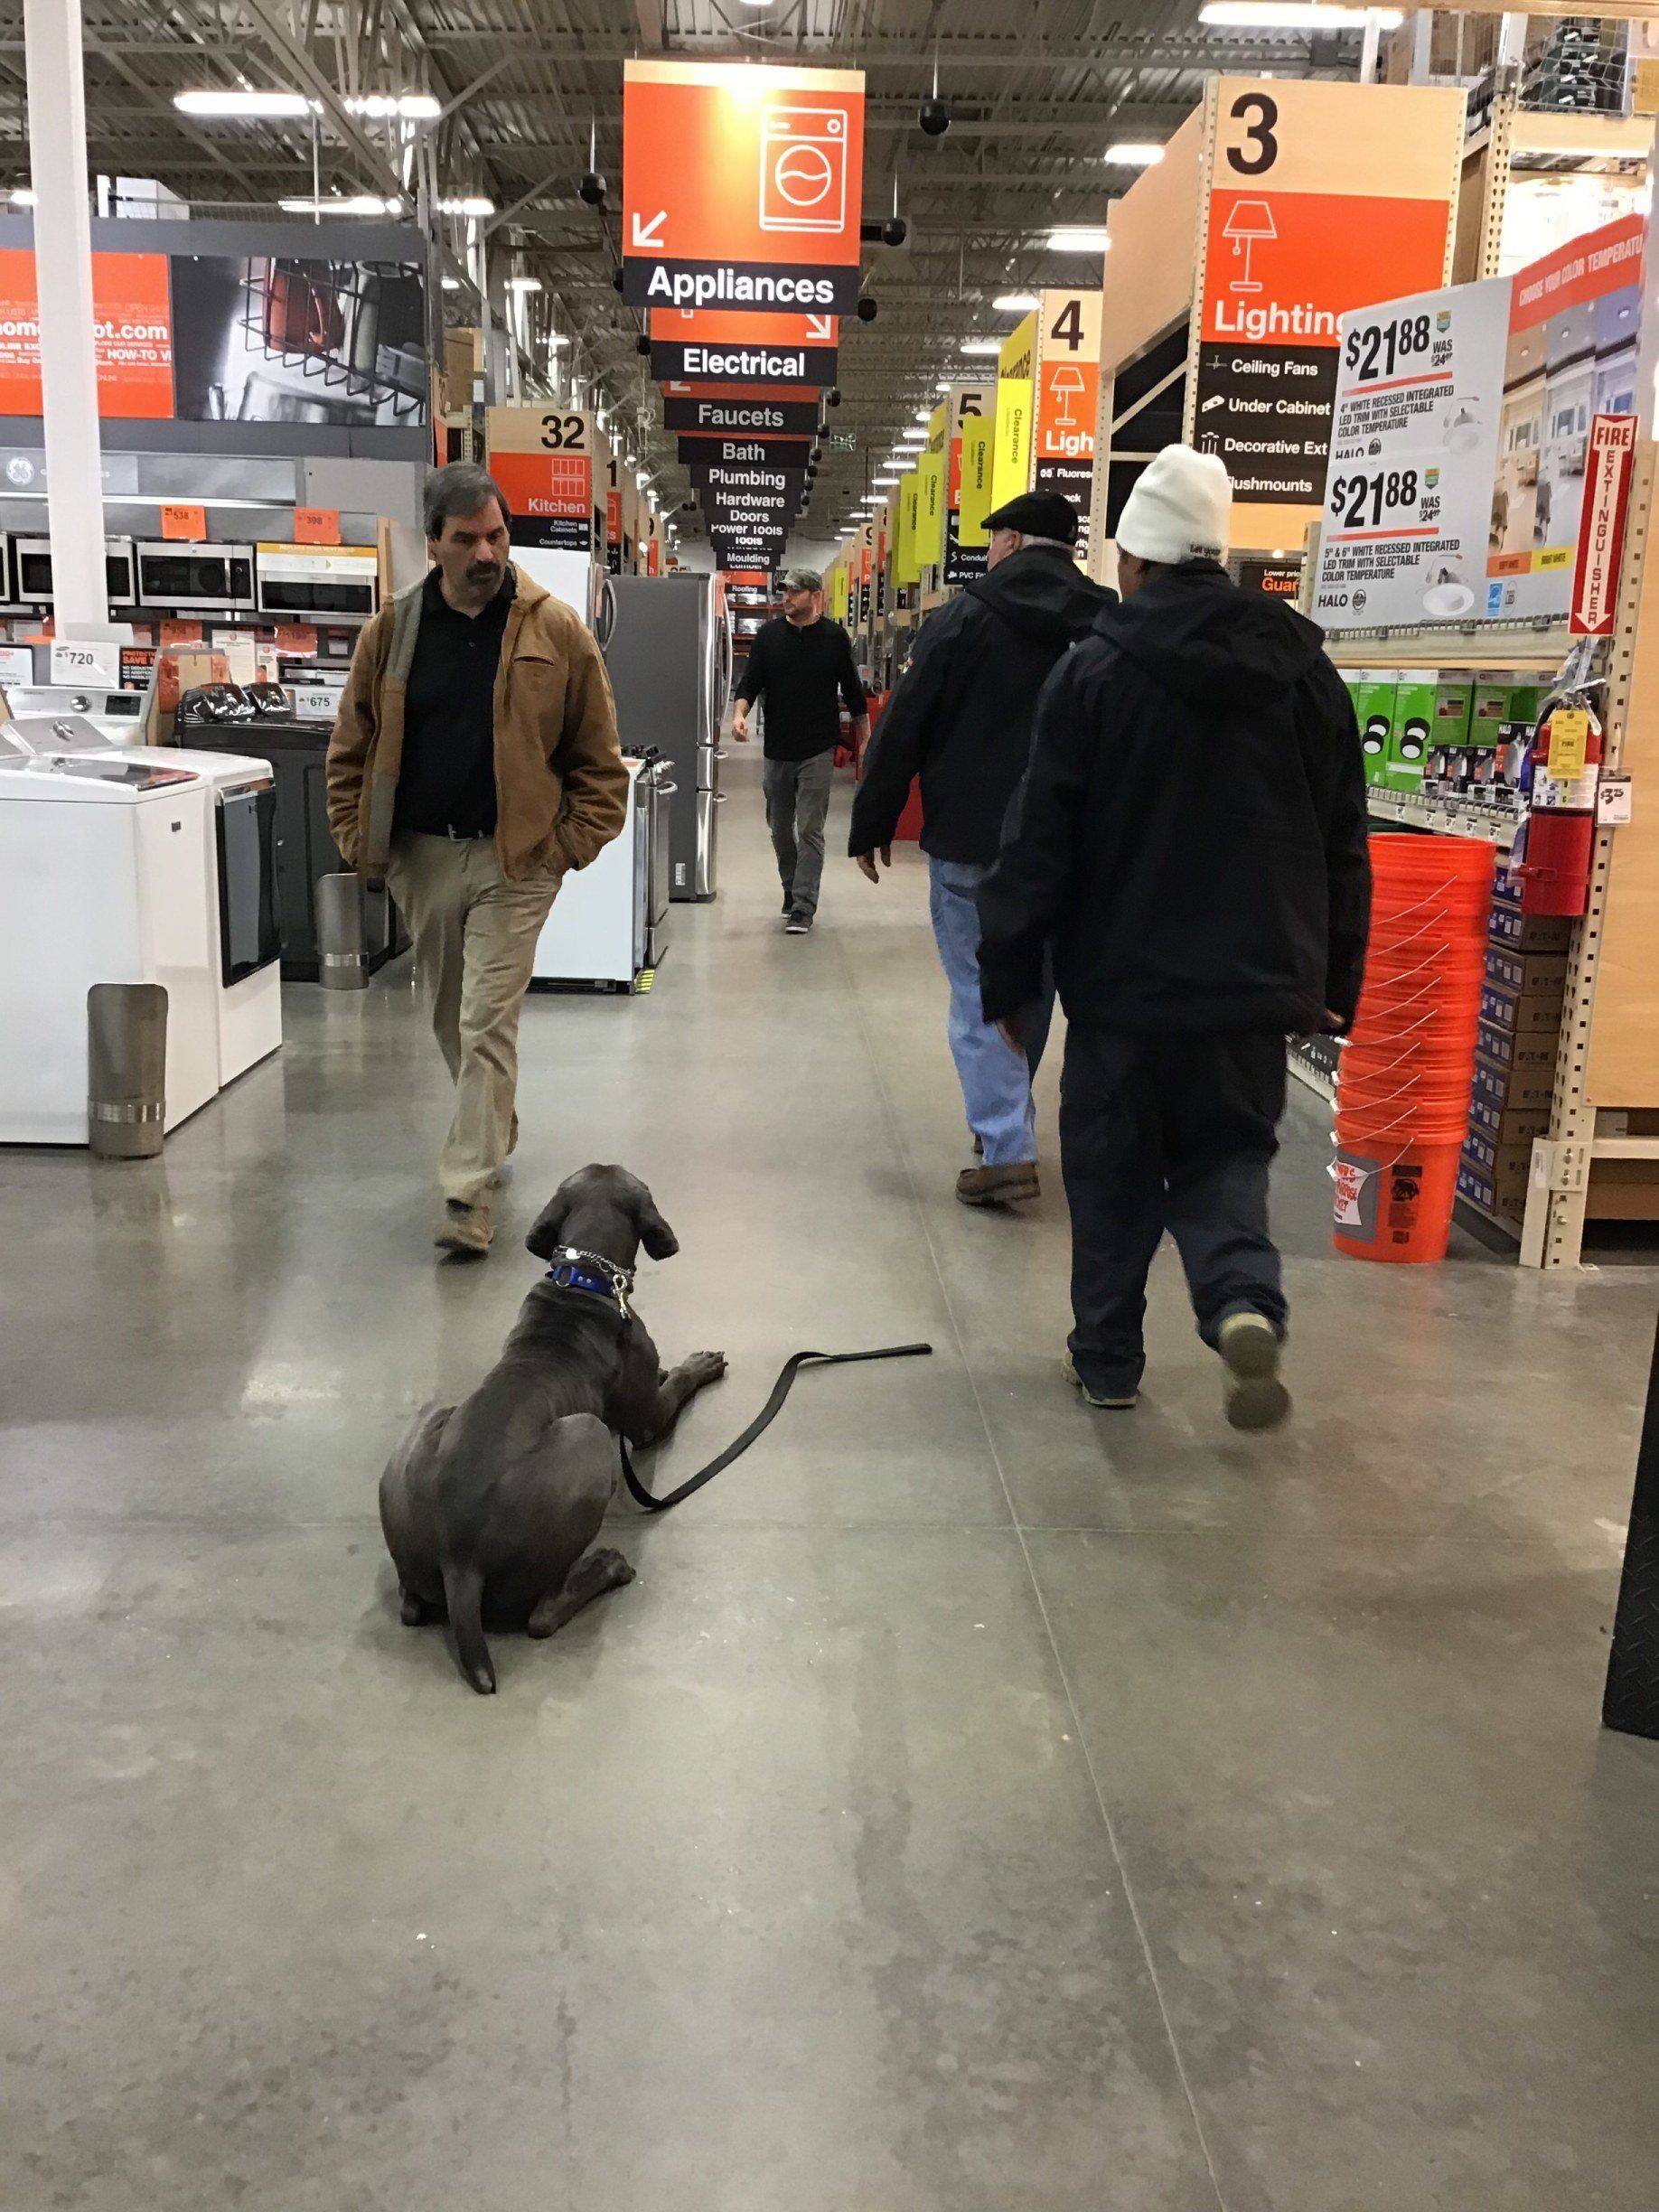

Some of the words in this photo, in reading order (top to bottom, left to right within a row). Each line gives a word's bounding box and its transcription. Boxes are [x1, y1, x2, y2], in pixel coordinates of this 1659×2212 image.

[1227, 92, 1278, 175] 3
[647, 266, 834, 306] Appliances
[1050, 300, 1084, 351] 4
[107, 349, 157, 361] HOW-TO
[1432, 339, 1452, 353] WAS
[683, 348, 805, 377] Electrical
[1231, 358, 1280, 378] Ceiling
[1284, 361, 1318, 376] Fans
[1228, 398, 1273, 414] Under
[1276, 401, 1331, 416] Cabinet
[1350, 398, 1371, 412] WHITE
[1373, 394, 1405, 409] RECESSED
[1406, 385, 1454, 401] INTEGRATED
[698, 404, 784, 426] Faucets
[958, 393, 981, 429] 5
[1339, 414, 1352, 426] LED
[1354, 411, 1370, 424] TRIM
[1372, 408, 1388, 421] WITH
[1390, 400, 1433, 418] SELECTABLE
[541, 415, 585, 449] 32
[1011, 408, 1023, 464] Clearance
[1338, 425, 1359, 438] COLOR
[1362, 417, 1408, 435] TEMPERATURE
[1597, 426, 1630, 446] FIRE
[723, 442, 765, 461] Bath
[1224, 437, 1300, 455] Decorative
[1304, 441, 1328, 455] Ext
[606, 460, 616, 486] 1
[976, 440, 986, 490] Clearance
[708, 468, 785, 490] Plumbing
[716, 492, 785, 508] Hardware
[929, 474, 937, 516] Clearance
[1420, 496, 1440, 509] WAS
[528, 498, 586, 514] Kitchen
[730, 510, 770, 522] Doors
[550, 526, 577, 534] Cabinets
[1588, 450, 1615, 624] EXTINGUISHER
[961, 553, 988, 562] Conduit
[1335, 547, 1341, 557] &
[1352, 545, 1373, 557] WHITE
[1374, 542, 1411, 555] RECESSED
[1412, 539, 1460, 553] INTEGRATED
[726, 552, 770, 566] Moulding
[1323, 559, 1336, 570] LED
[1338, 558, 1355, 569] TRIM
[1357, 557, 1374, 568] WITH
[1375, 554, 1420, 567] SELECTABLE
[1263, 568, 1285, 577] Lower
[1322, 570, 1345, 582] COLOR
[1346, 567, 1395, 581] TEMPERATURE
[732, 586, 758, 594] Roofing
[1317, 594, 1348, 608] HALO
[122, 656, 146, 665] SAVE
